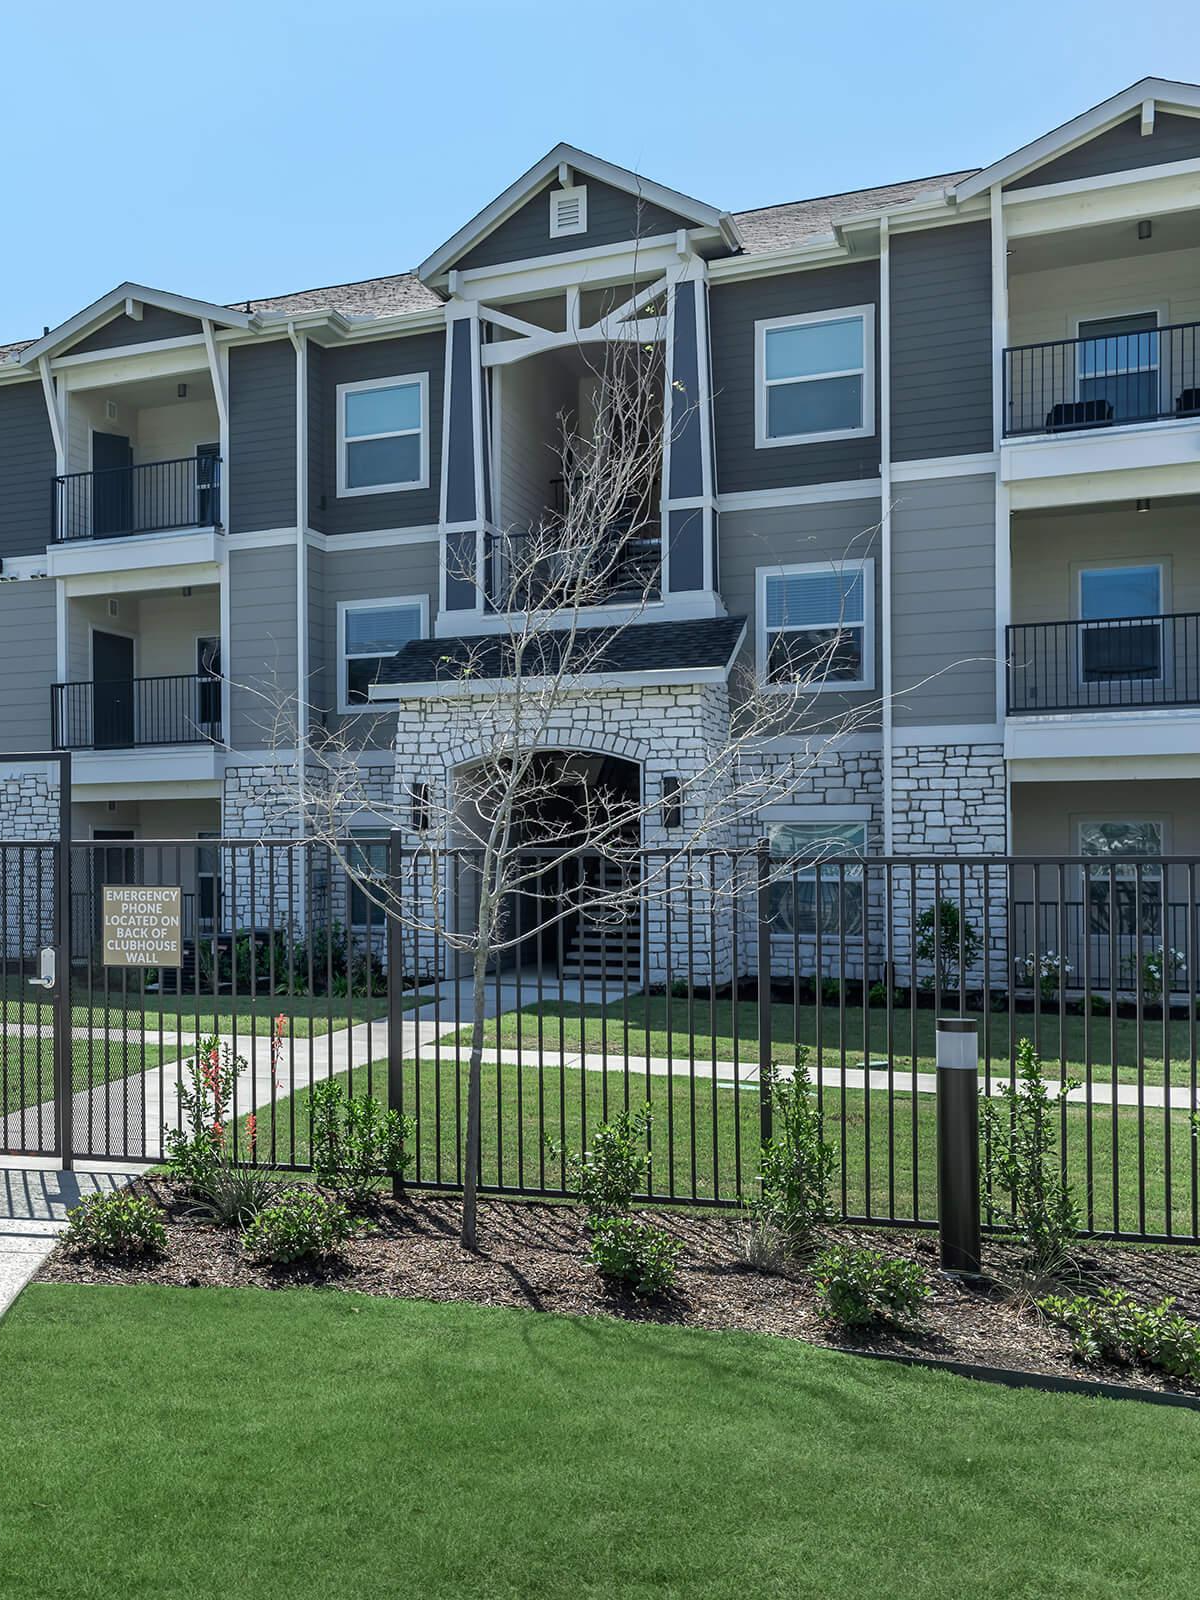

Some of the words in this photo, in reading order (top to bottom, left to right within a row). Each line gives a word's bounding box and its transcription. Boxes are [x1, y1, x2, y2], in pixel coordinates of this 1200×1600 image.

[106, 890, 178, 902] EMERGENCY
[121, 903, 163, 914] PHONE
[105, 915, 158, 926] LOCATED
[161, 915, 179, 926] ON
[116, 927, 148, 938] BACK
[151, 928, 168, 938] OF
[106, 940, 177, 951] CLUBHOUSE
[125, 952, 159, 964] WALL
